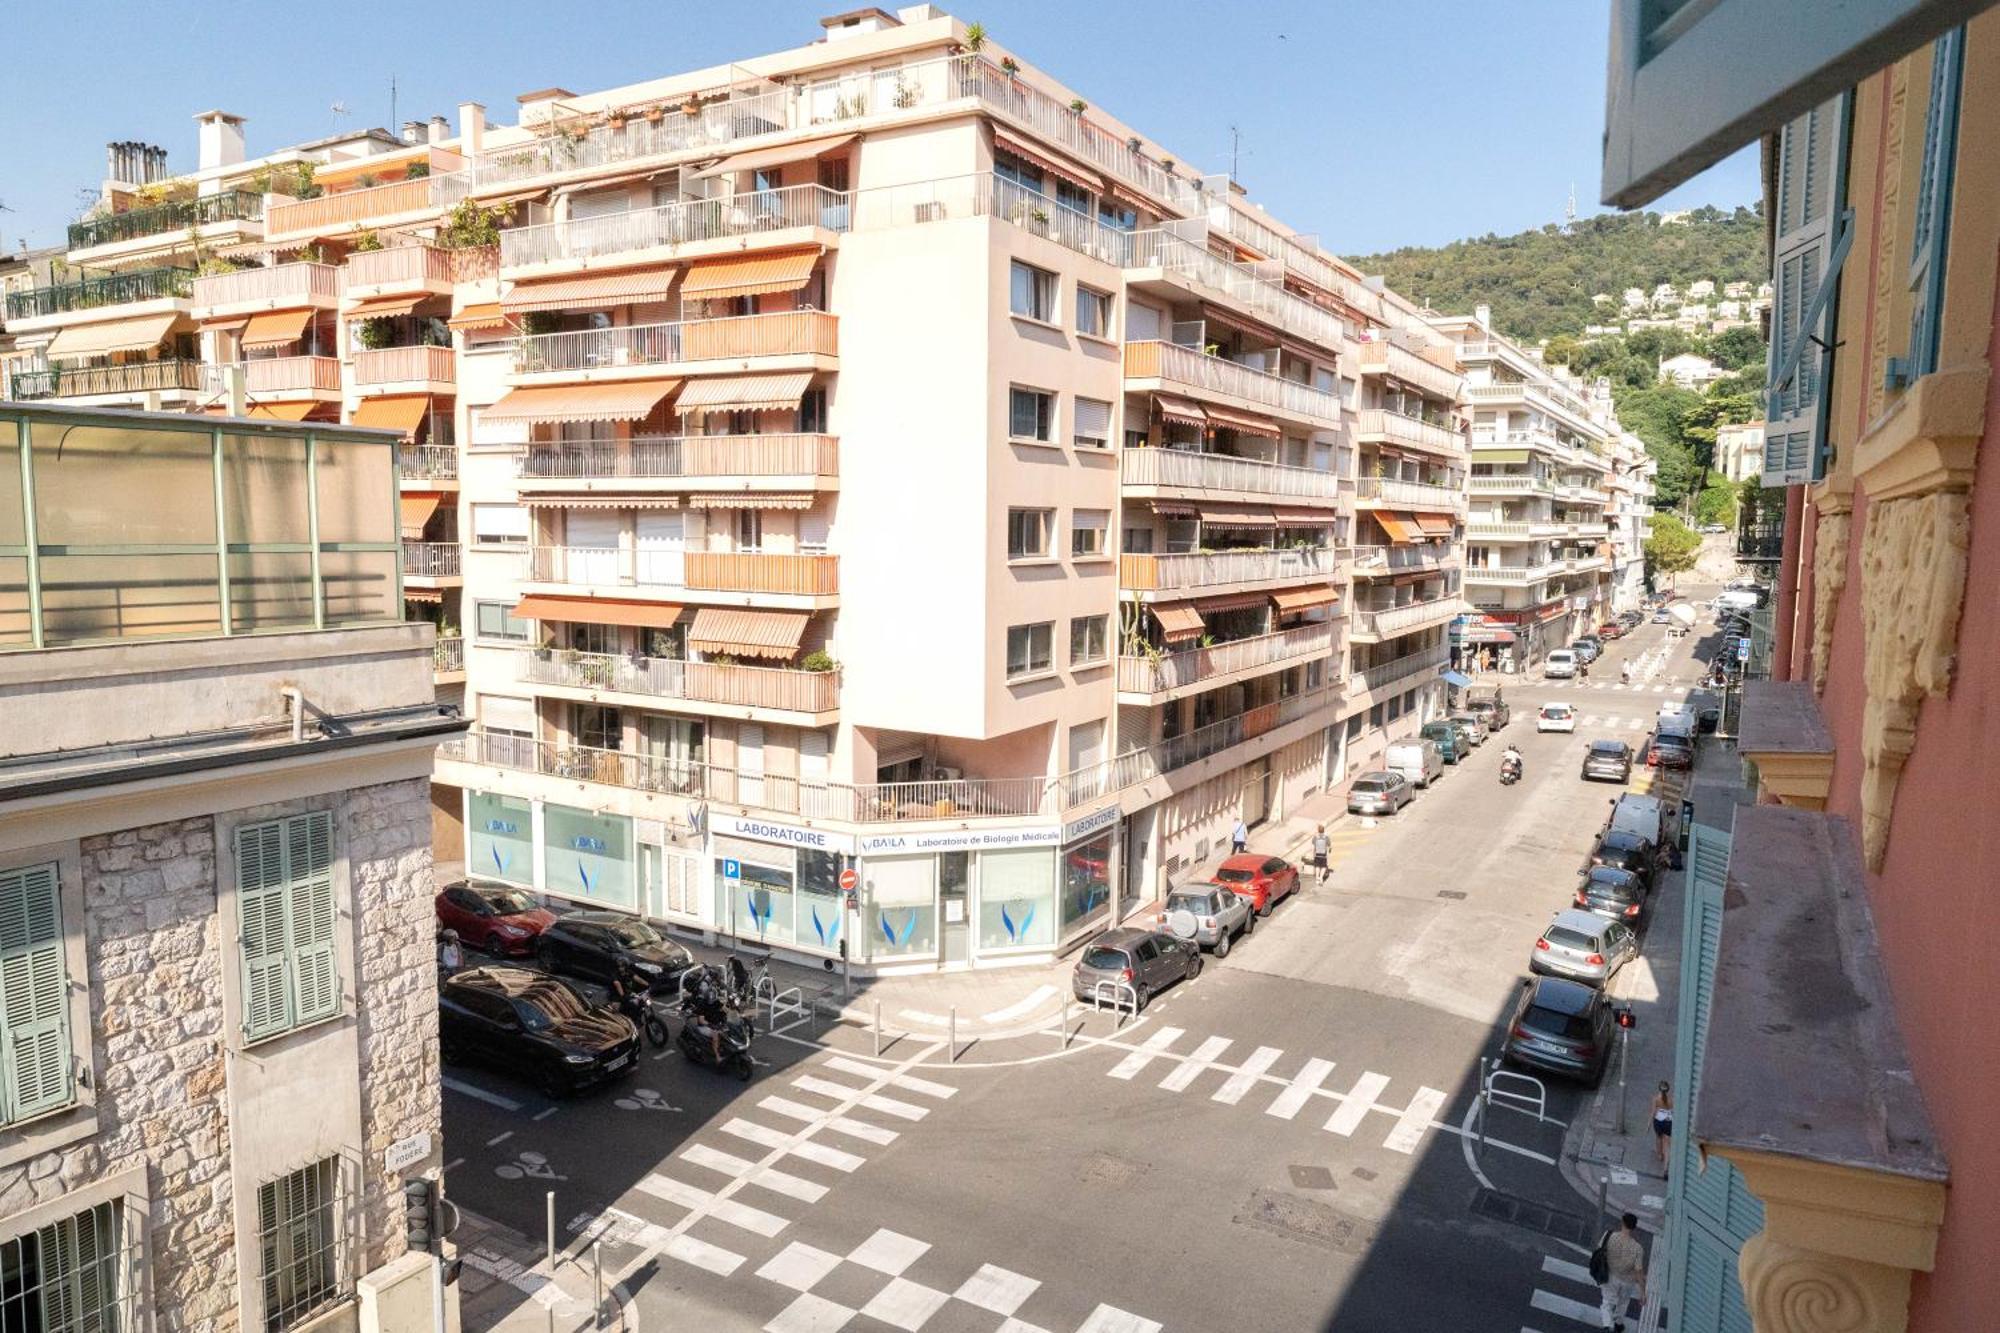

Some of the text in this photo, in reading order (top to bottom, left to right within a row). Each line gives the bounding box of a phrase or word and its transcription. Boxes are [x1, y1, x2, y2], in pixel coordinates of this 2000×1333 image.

[1071, 808, 1116, 836] LABORATOIRE
[735, 821, 825, 846] LABORATOIRE
[916, 837, 968, 848] Laboratoire
[970, 836, 981, 845] de
[983, 834, 1019, 844] Biologie
[727, 862, 736, 876] P
[403, 1140, 416, 1151] RUE
